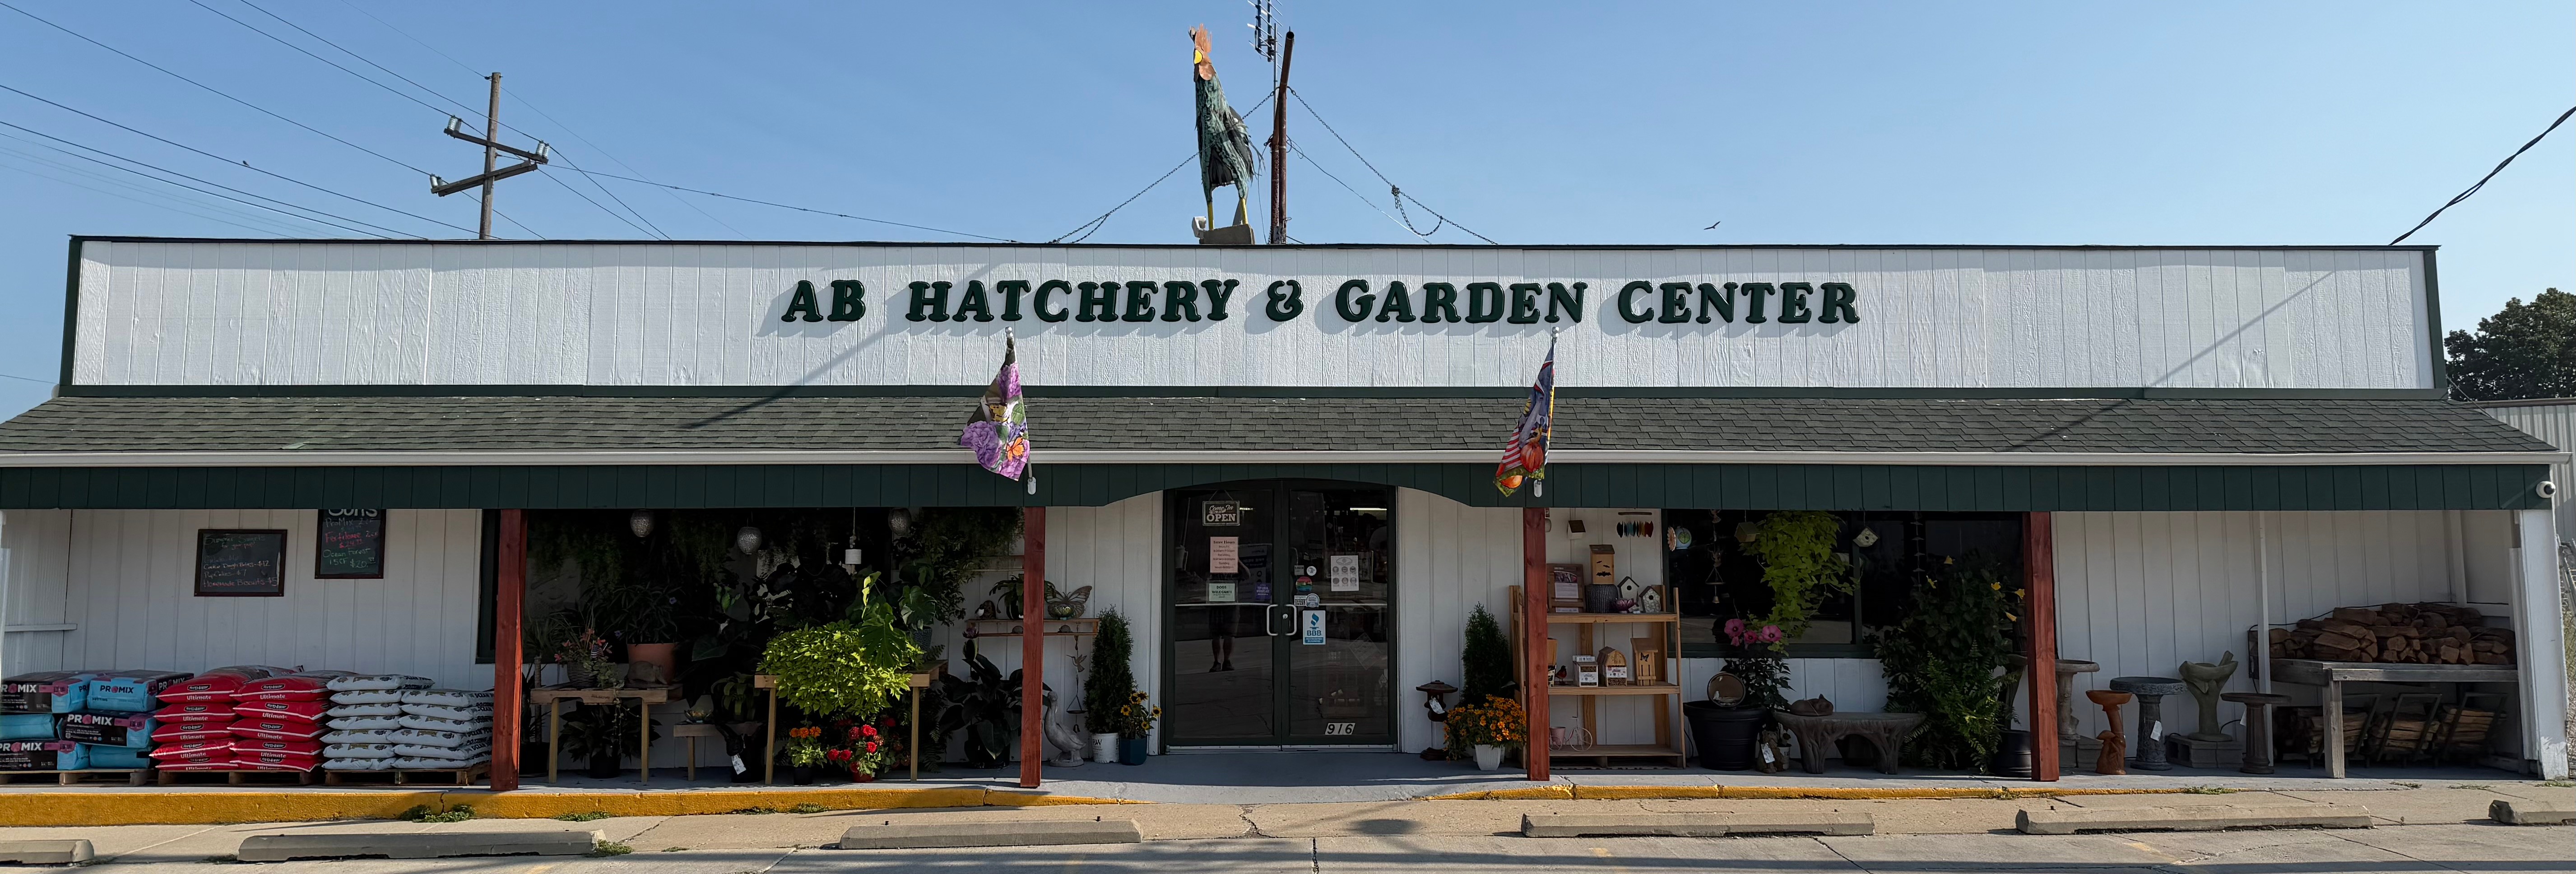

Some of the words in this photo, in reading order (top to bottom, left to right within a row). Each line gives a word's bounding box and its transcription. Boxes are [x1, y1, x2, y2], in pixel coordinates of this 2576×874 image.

[781, 280, 866, 322] AB
[905, 279, 1239, 322] HATCHERY
[1266, 279, 1304, 321] &
[1335, 279, 1588, 324] GARDEN
[1618, 280, 1860, 324] CENTER
[323, 549, 346, 558] Ocean
[1327, 724, 1353, 734] 916
